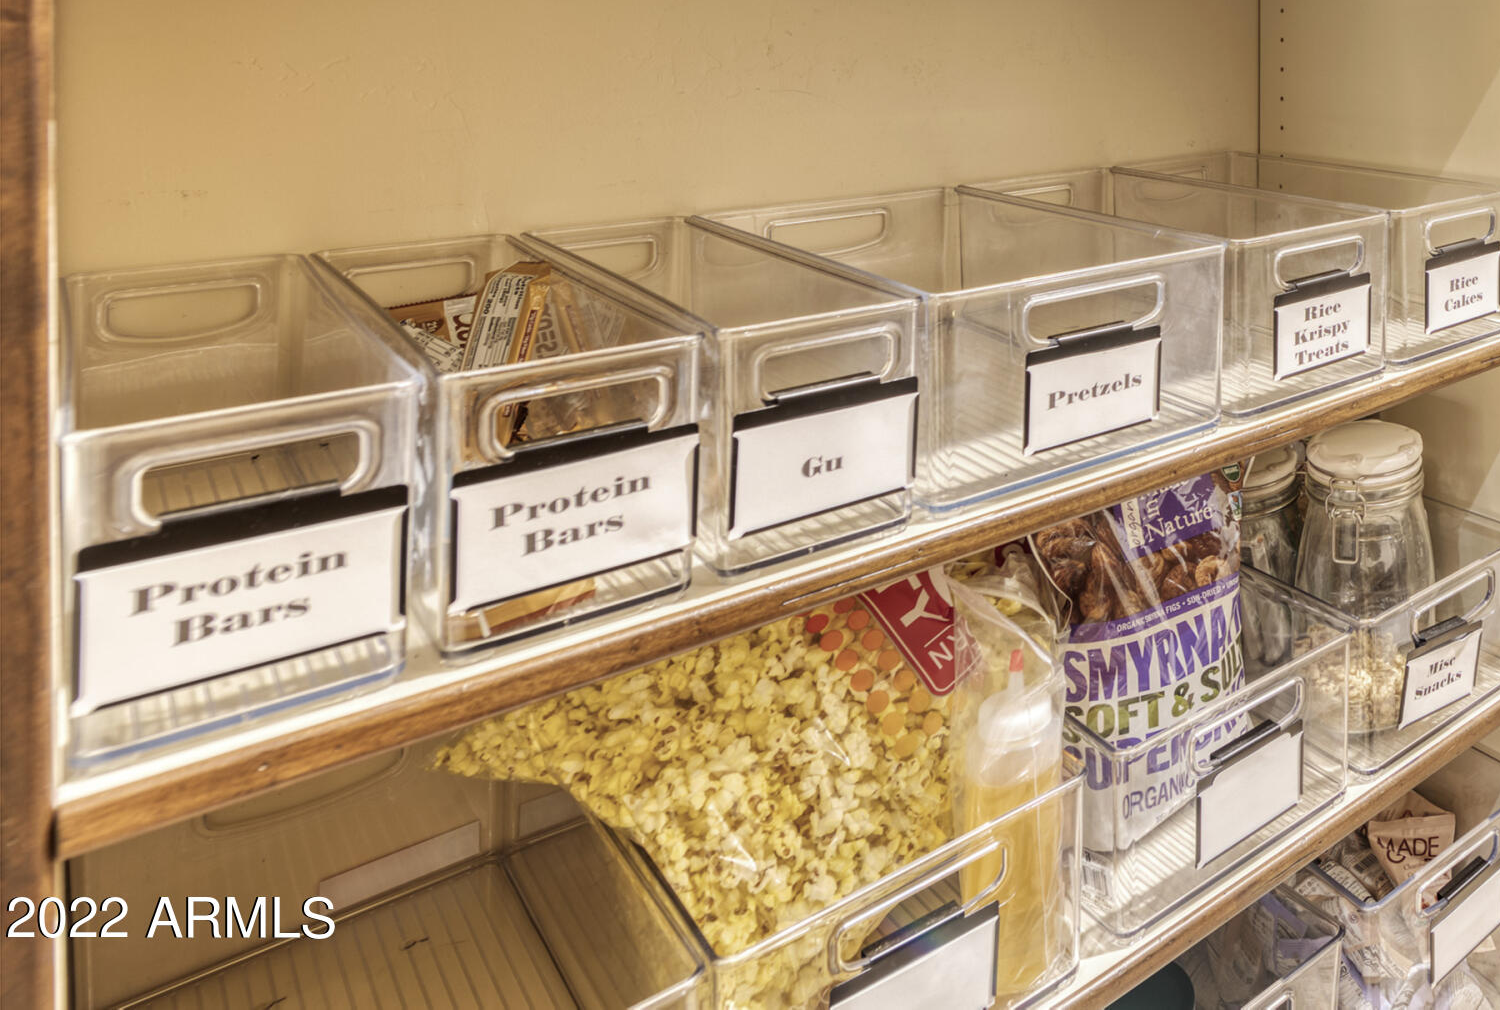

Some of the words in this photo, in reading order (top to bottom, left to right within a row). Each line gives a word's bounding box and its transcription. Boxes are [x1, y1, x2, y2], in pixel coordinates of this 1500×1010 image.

[1443, 289, 1485, 312] Cakes
[1449, 274, 1480, 294] Rice
[1302, 300, 1344, 322] Rice
[1292, 318, 1352, 348] Krispy
[1293, 336, 1351, 367] Treats
[1045, 370, 1144, 413] Pretzels
[801, 453, 845, 480] Gu
[489, 473, 653, 531] Protein
[521, 512, 626, 558] Bars
[1144, 505, 1215, 544] Nature
[129, 548, 349, 620] Protein
[171, 594, 312, 648] Bars
[1165, 601, 1181, 615] FIGS
[1063, 605, 1227, 703] SMYRNA
[1427, 652, 1459, 676] Misc
[1413, 666, 1466, 703] Snacks
[1062, 690, 1165, 744] SOFT
[1171, 680, 1195, 718] &
[1377, 836, 1440, 858] MADE
